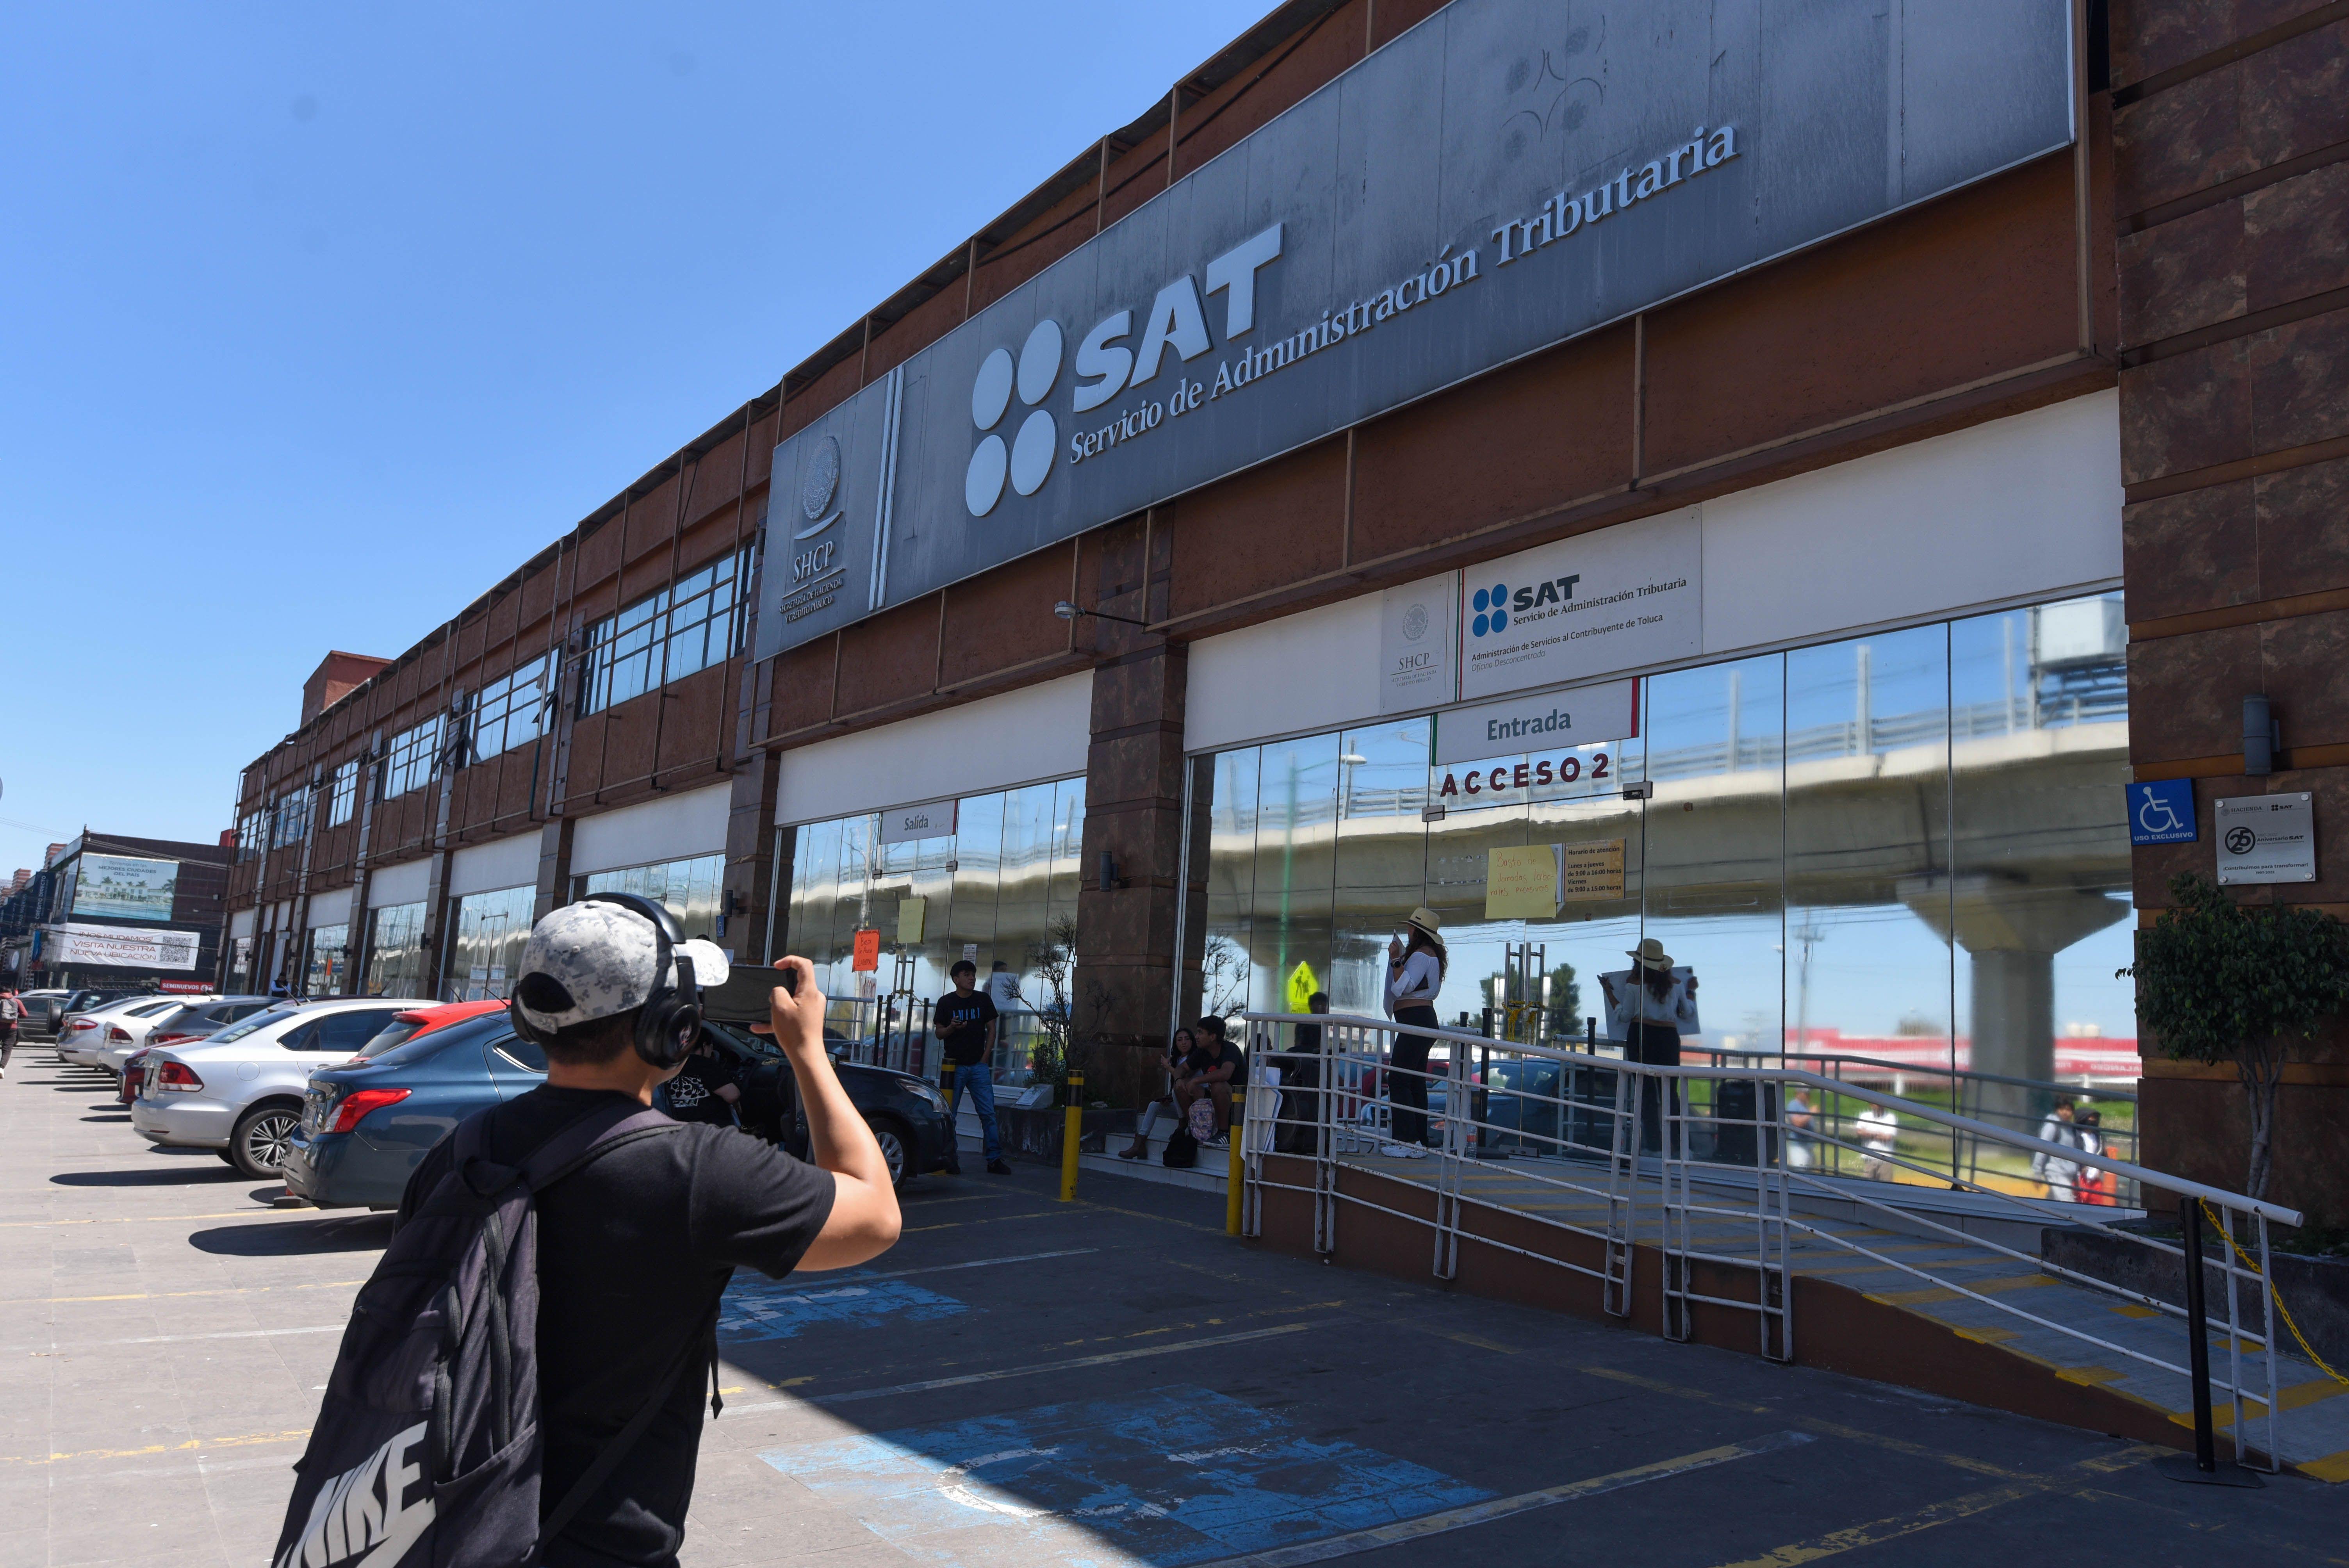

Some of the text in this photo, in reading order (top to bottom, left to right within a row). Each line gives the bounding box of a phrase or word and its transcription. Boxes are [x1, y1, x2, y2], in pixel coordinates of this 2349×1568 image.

[1070, 126, 1739, 464] Servicio de Administración Tributaria
[1073, 222, 1284, 413] SAT
[793, 541, 834, 583] SHCP
[807, 591, 814, 600] DE
[814, 578, 842, 597] HACIENDA
[1513, 574, 1580, 612] SAT
[1513, 578, 1687, 625] Servicio de Administración Tributaria
[785, 615, 789, 624] Y
[1472, 614, 1663, 661] Administración de Servicios al Contribuyente de Toluca
[1399, 652, 1429, 670] SHCP
[1471, 650, 1545, 673] Oficina Desconcentrada
[1487, 709, 1572, 741] Entrada
[1440, 753, 1609, 797] ACCESO 2
[904, 814, 929, 831] Salida
[2230, 830, 2251, 851] 25
[1496, 851, 1537, 868] Basta de
[73, 939, 156, 952] VISITA NUESTRA
[288, 1420, 428, 1568] NIKE
